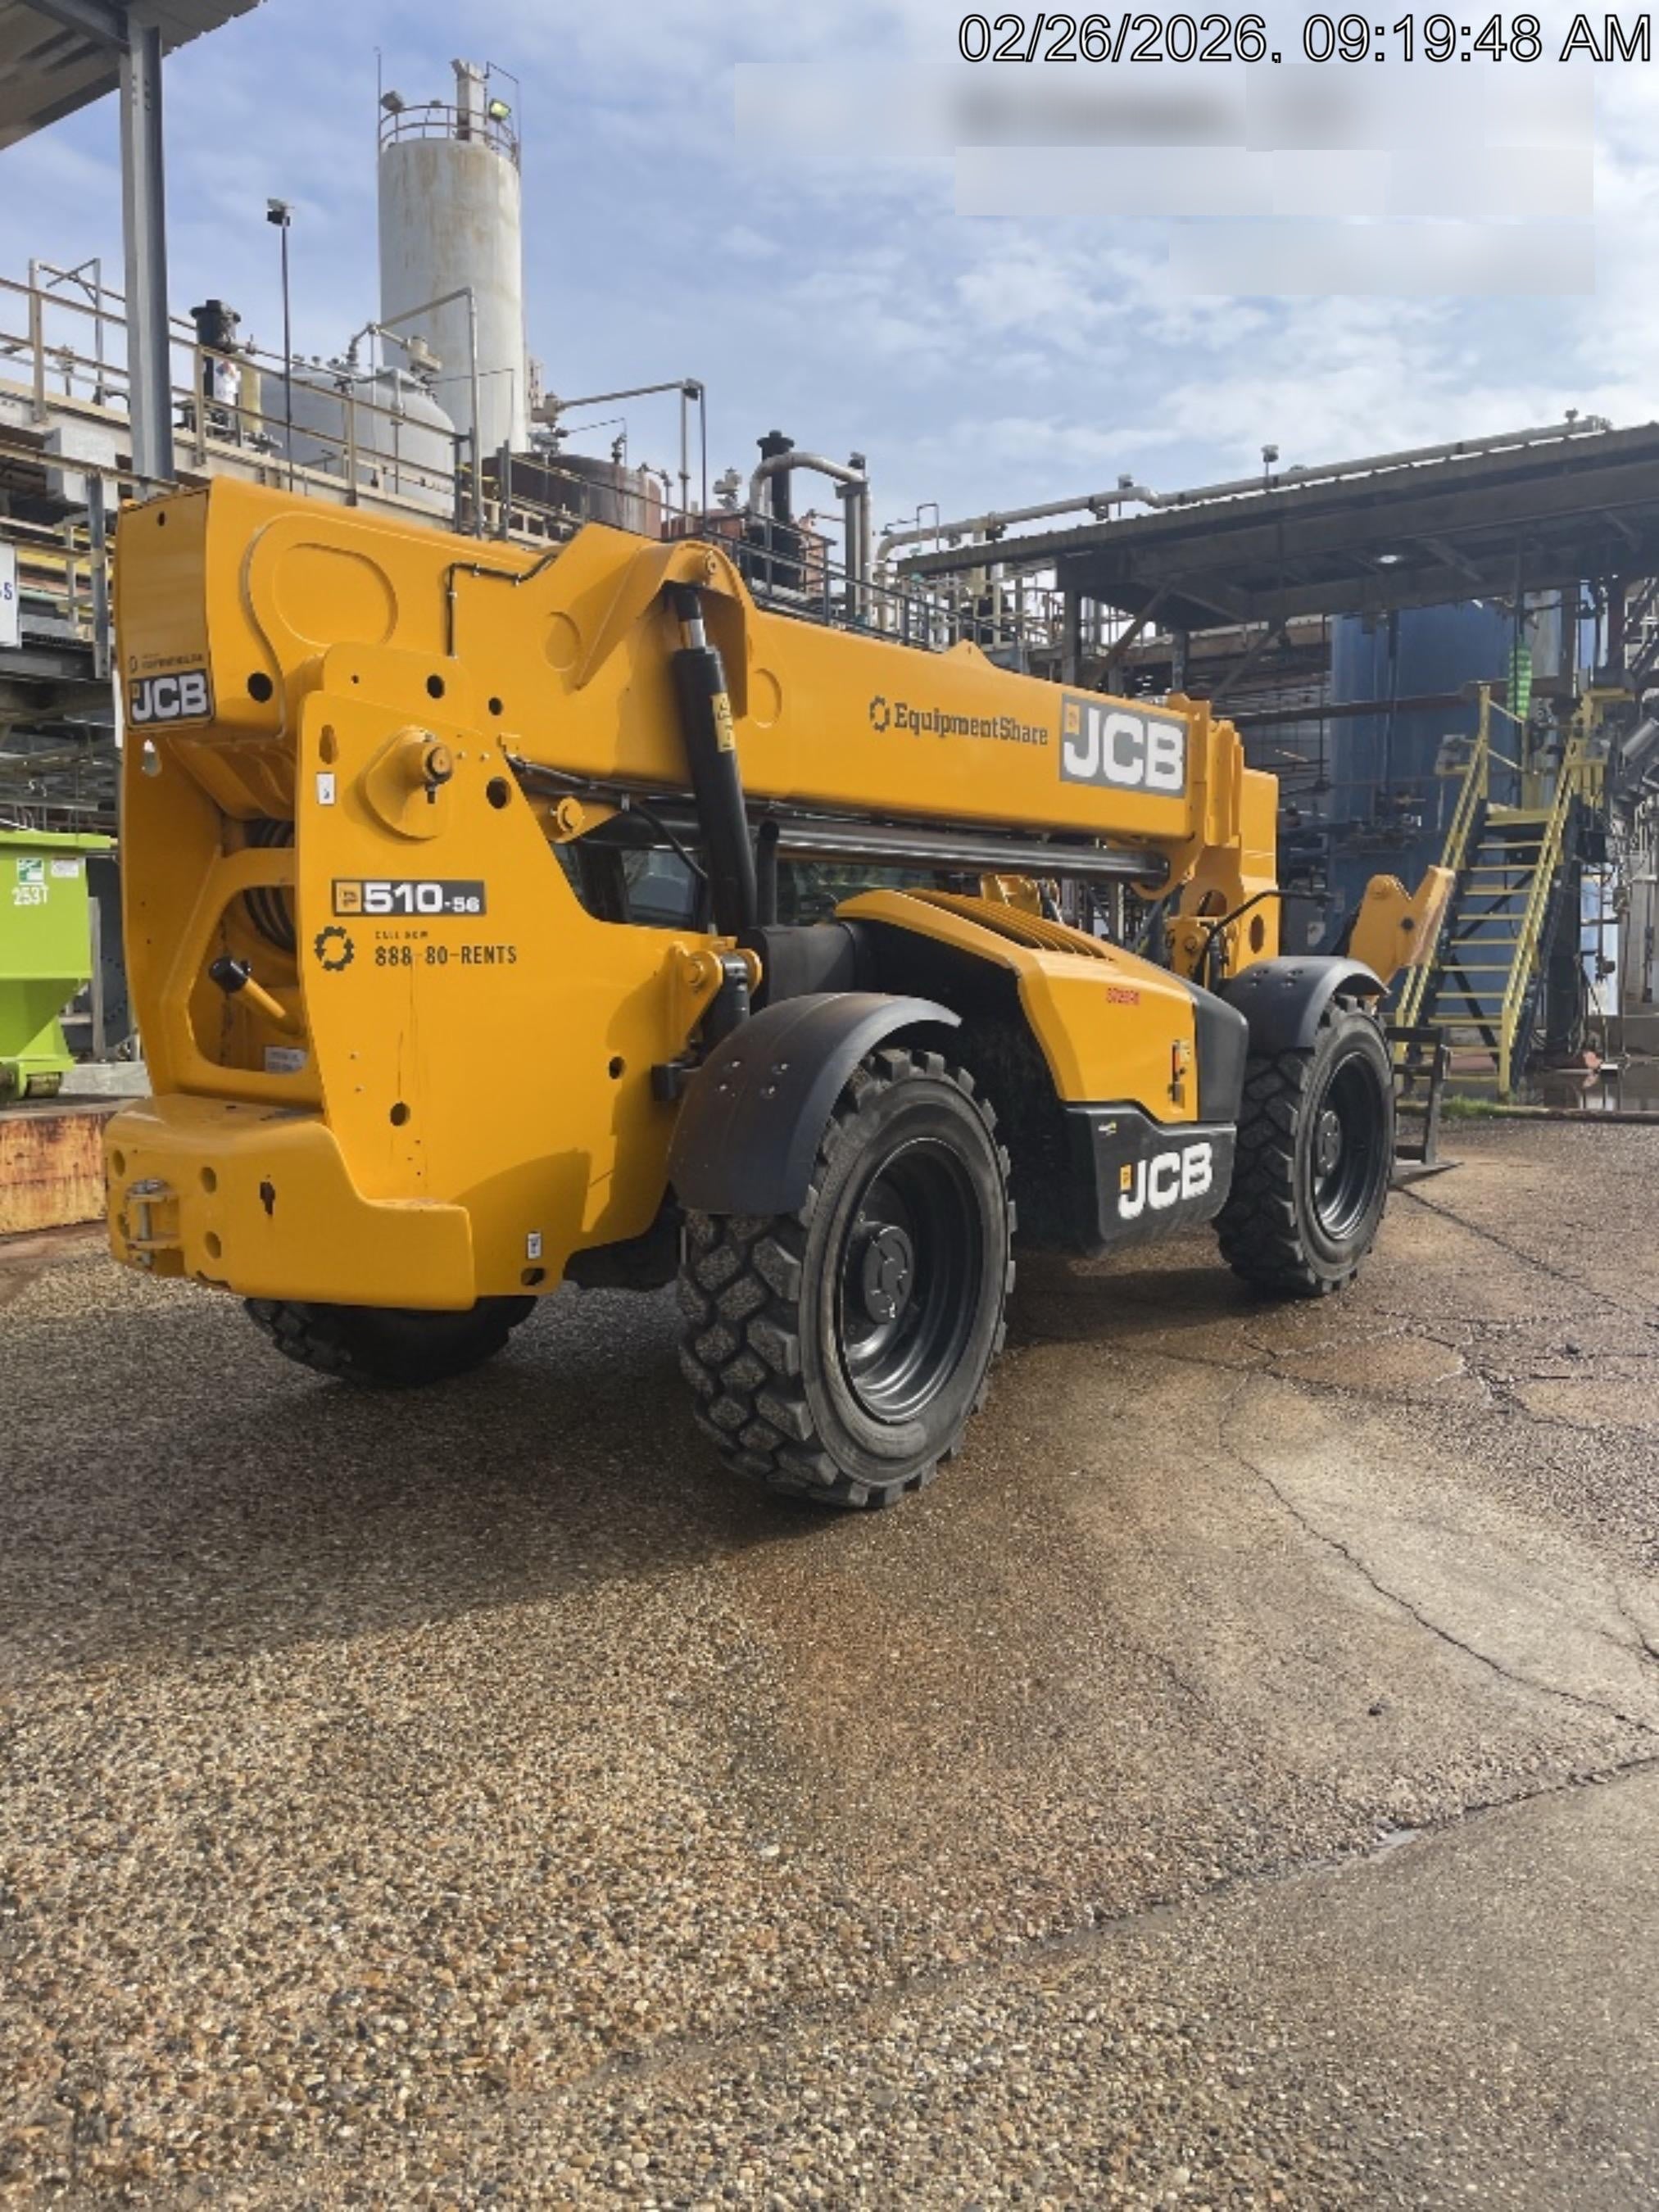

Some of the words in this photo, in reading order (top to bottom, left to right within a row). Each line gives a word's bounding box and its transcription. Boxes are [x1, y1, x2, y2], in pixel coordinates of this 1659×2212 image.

[132, 673, 207, 721] JCB
[894, 702, 1049, 746] EquipmentShare
[1064, 706, 1185, 791] JCB
[364, 882, 480, 913] 510-56
[1117, 1142, 1213, 1220] JCB
